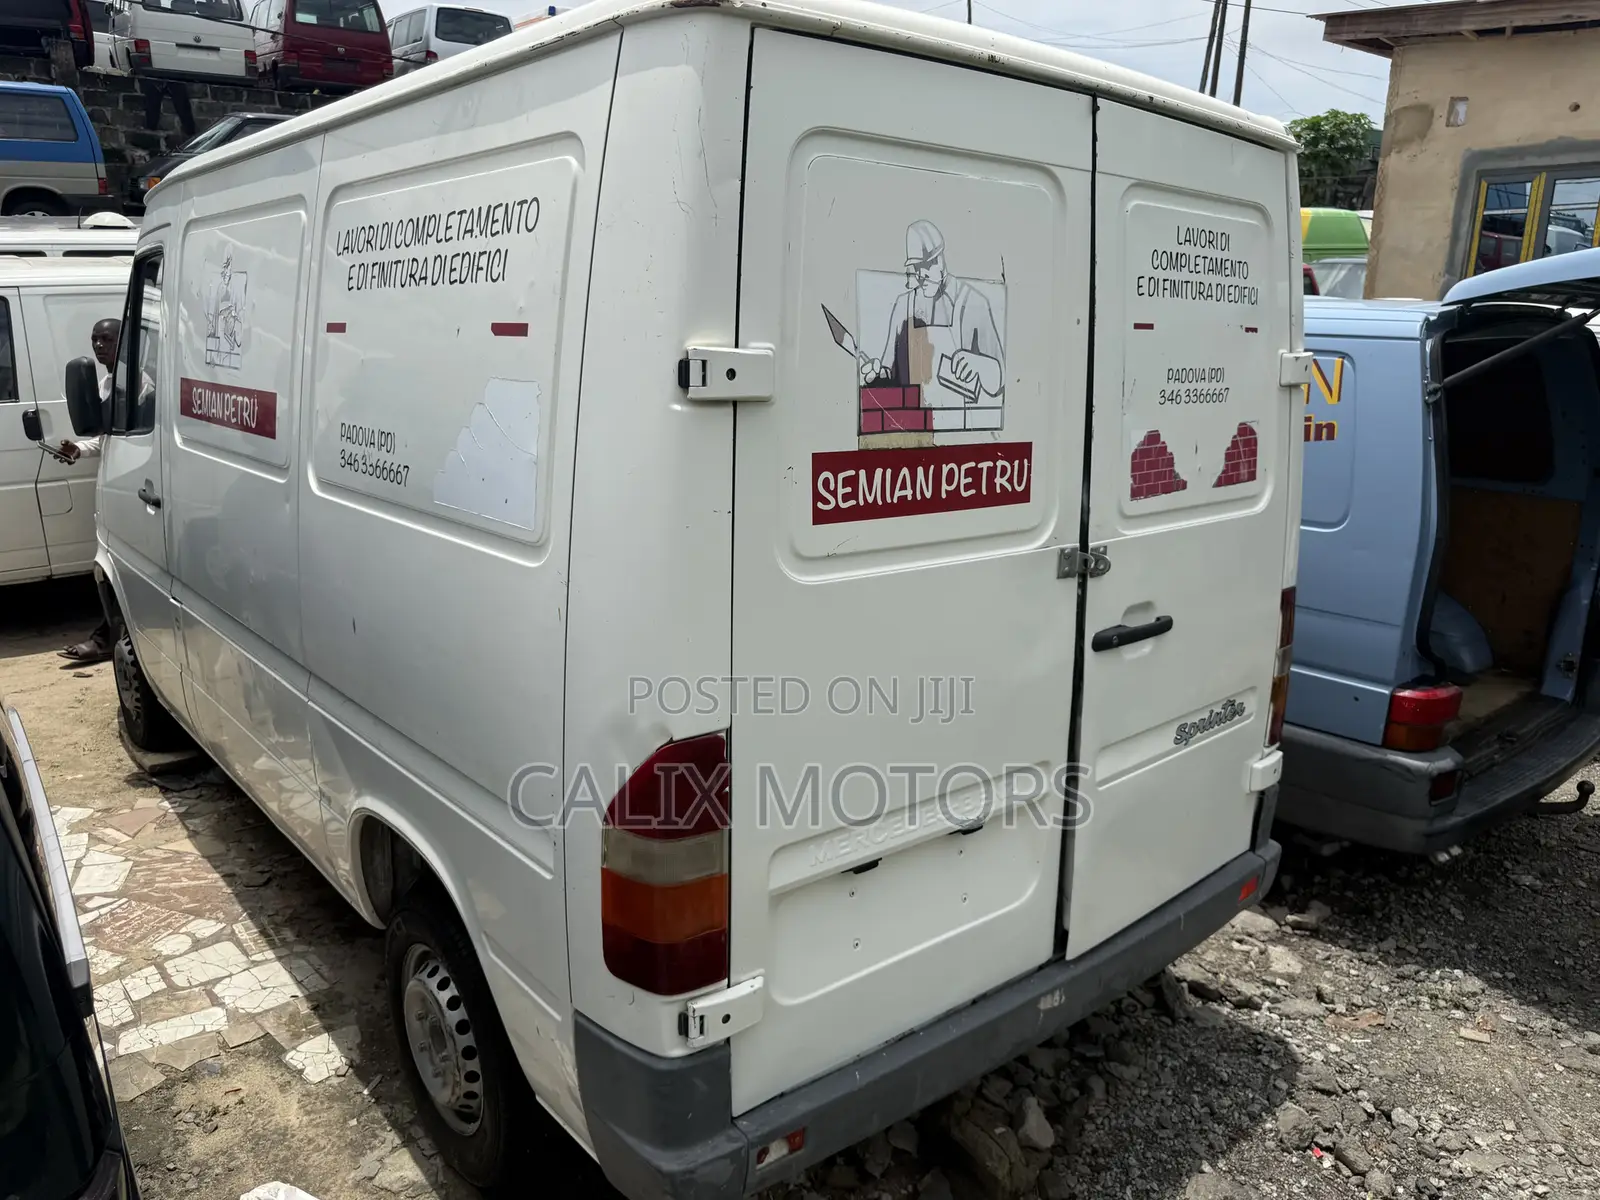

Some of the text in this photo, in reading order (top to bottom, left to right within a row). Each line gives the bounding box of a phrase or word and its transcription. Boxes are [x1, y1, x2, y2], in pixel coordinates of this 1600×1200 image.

[336, 196, 540, 257] LAVORI DI COMPLETAMENTO
[1176, 225, 1230, 252] LAVORI DI
[347, 248, 509, 292] E DI FINITURA DI EDIFICI
[1151, 249, 1249, 280] COMPLETAMENTO
[1136, 275, 1259, 305] E DI FINITURA DI EDIFICI
[1166, 366, 1225, 384] PADOVA (PD)
[192, 386, 223, 419] SEMIAN
[1158, 387, 1230, 406] 346 3366667
[340, 421, 396, 456] PADOVA (PD)
[816, 464, 935, 511] SEMIAN
